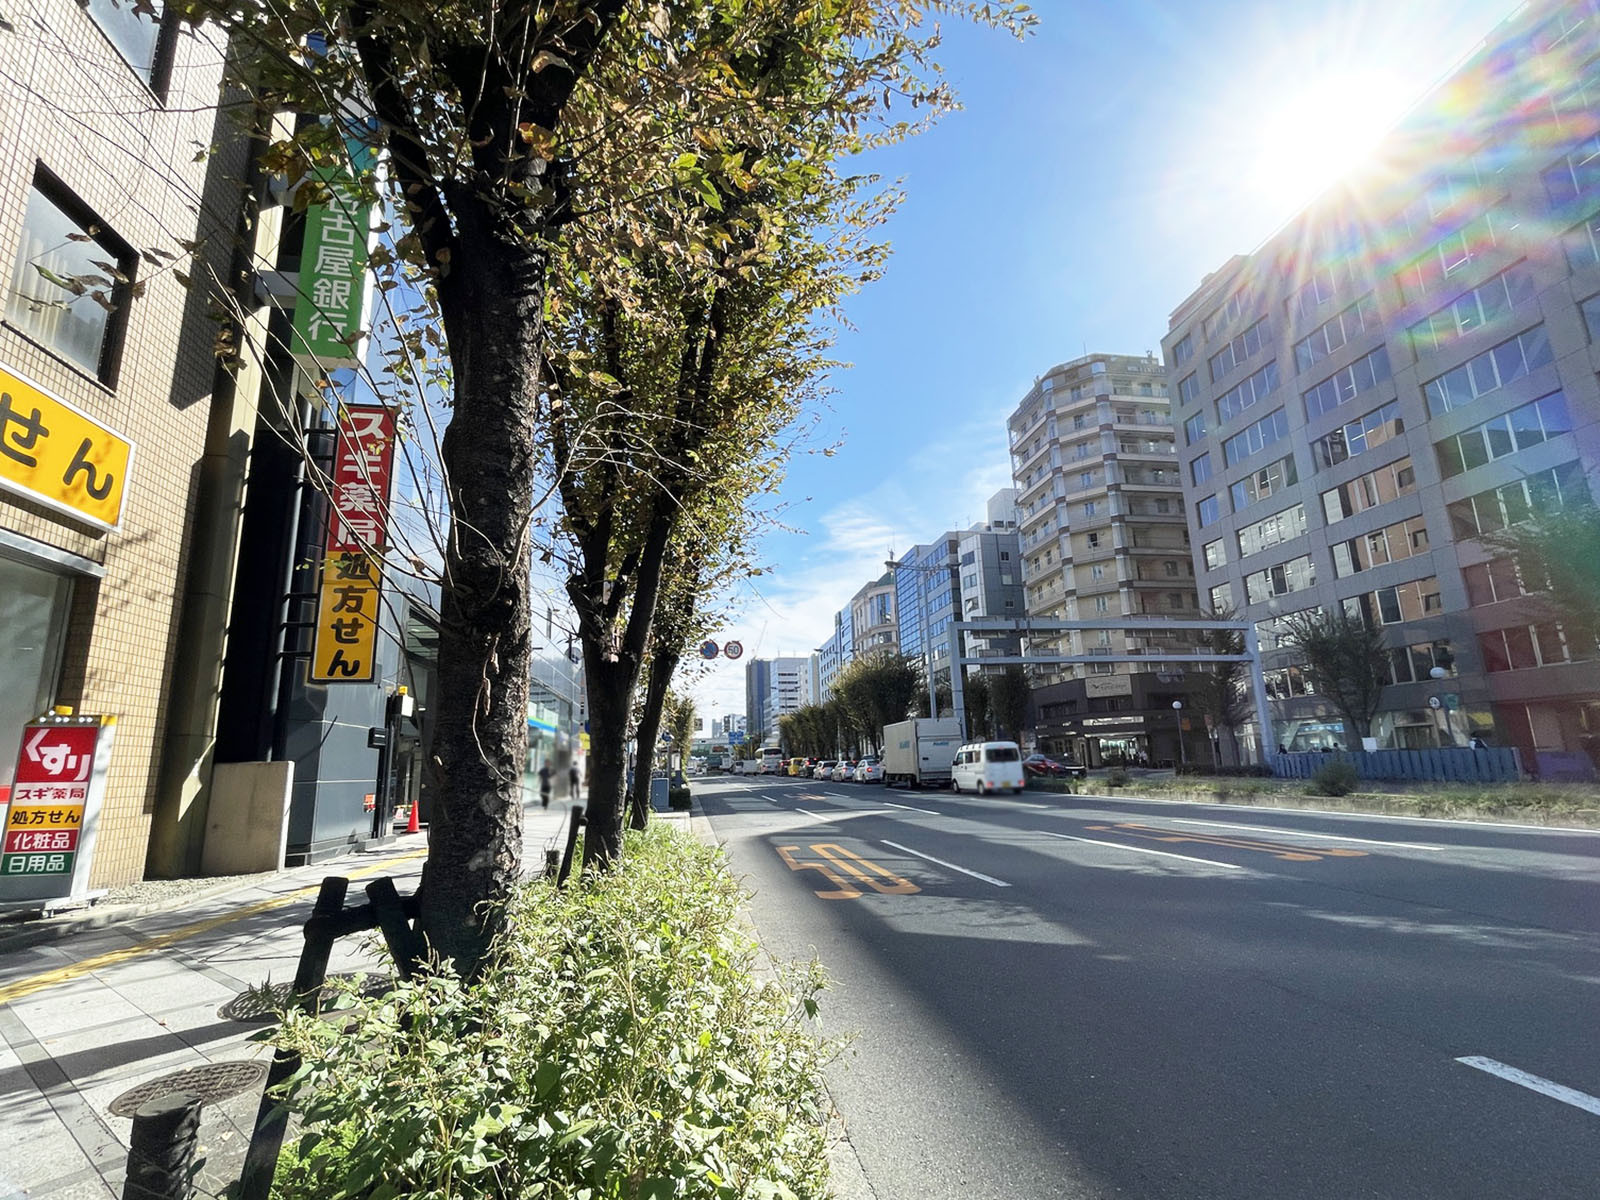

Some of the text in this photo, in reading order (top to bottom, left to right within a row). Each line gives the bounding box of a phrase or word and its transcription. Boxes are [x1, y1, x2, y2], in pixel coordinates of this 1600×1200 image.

[0, 392, 113, 500] せん
[335, 411, 386, 548] スギ薬局
[327, 552, 371, 678] 処方せん
[728, 645, 740, 655] 50
[25, 728, 91, 782] くすり
[15, 787, 85, 801] スギ薬局
[11, 809, 81, 825] 処方せん
[13, 831, 70, 851] 化粧品
[8, 854, 65, 874] 日用品
[776, 843, 922, 899] 50
